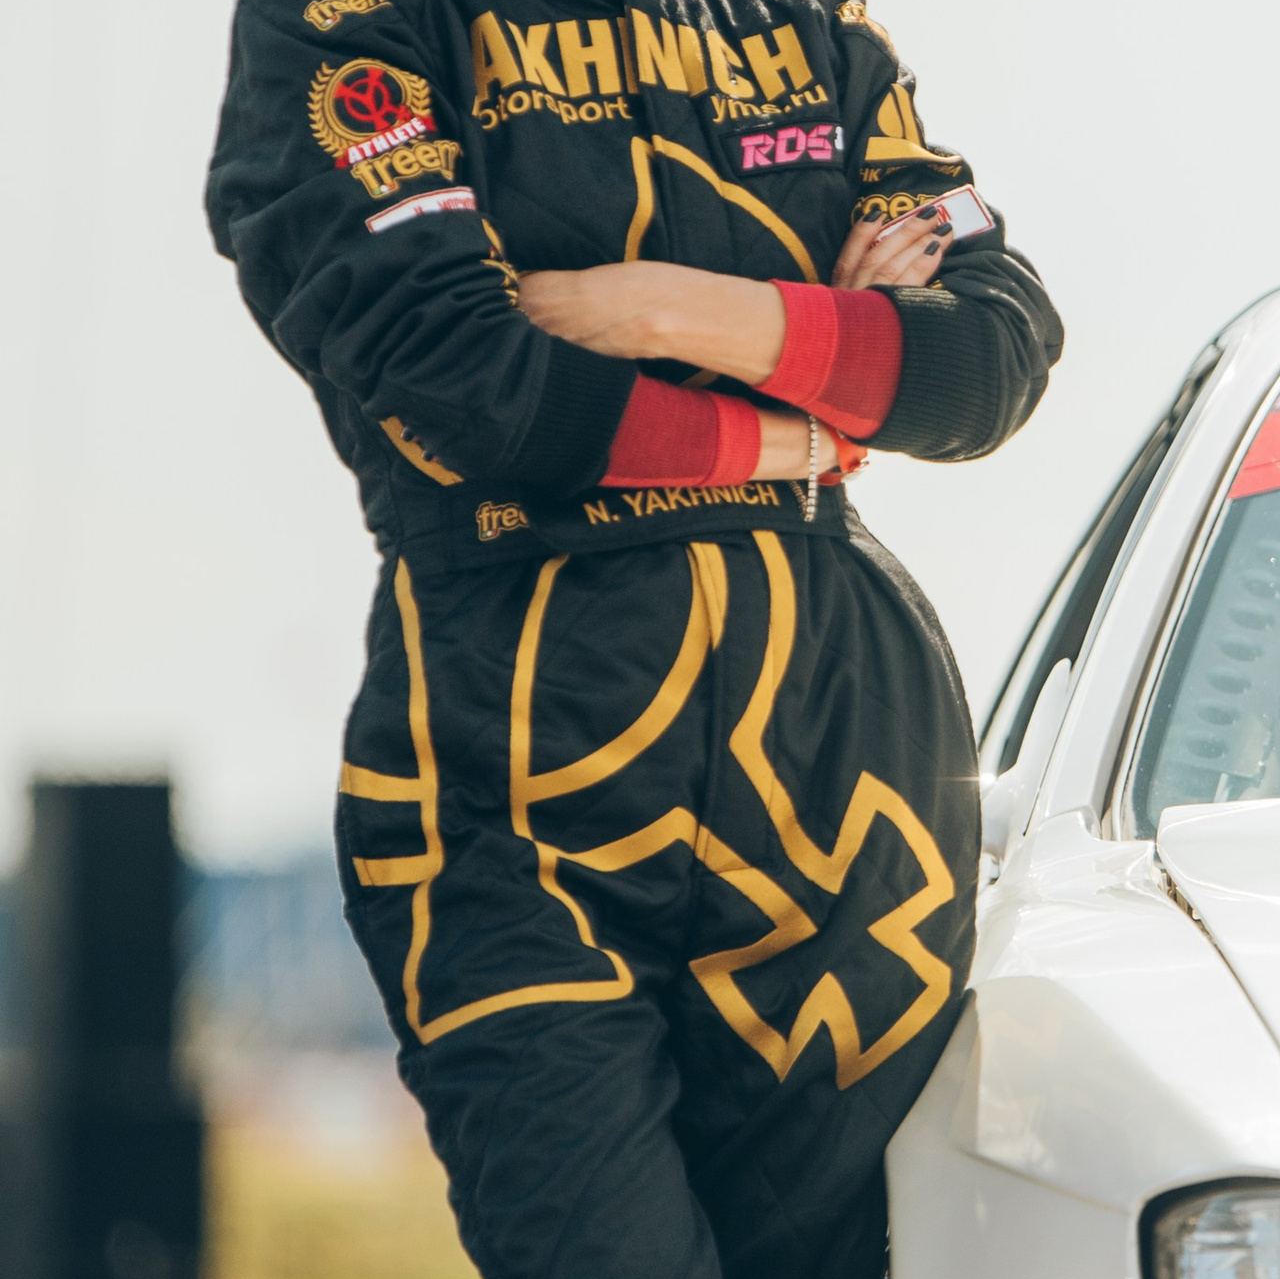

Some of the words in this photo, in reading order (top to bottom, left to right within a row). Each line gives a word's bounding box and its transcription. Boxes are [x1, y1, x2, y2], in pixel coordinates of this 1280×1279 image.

[711, 83, 829, 124] yms.ru
[347, 116, 428, 164] ATHLETE
[740, 124, 834, 169] RDS
[583, 499, 620, 525] N.
[621, 483, 780, 517] YAKHNICH
